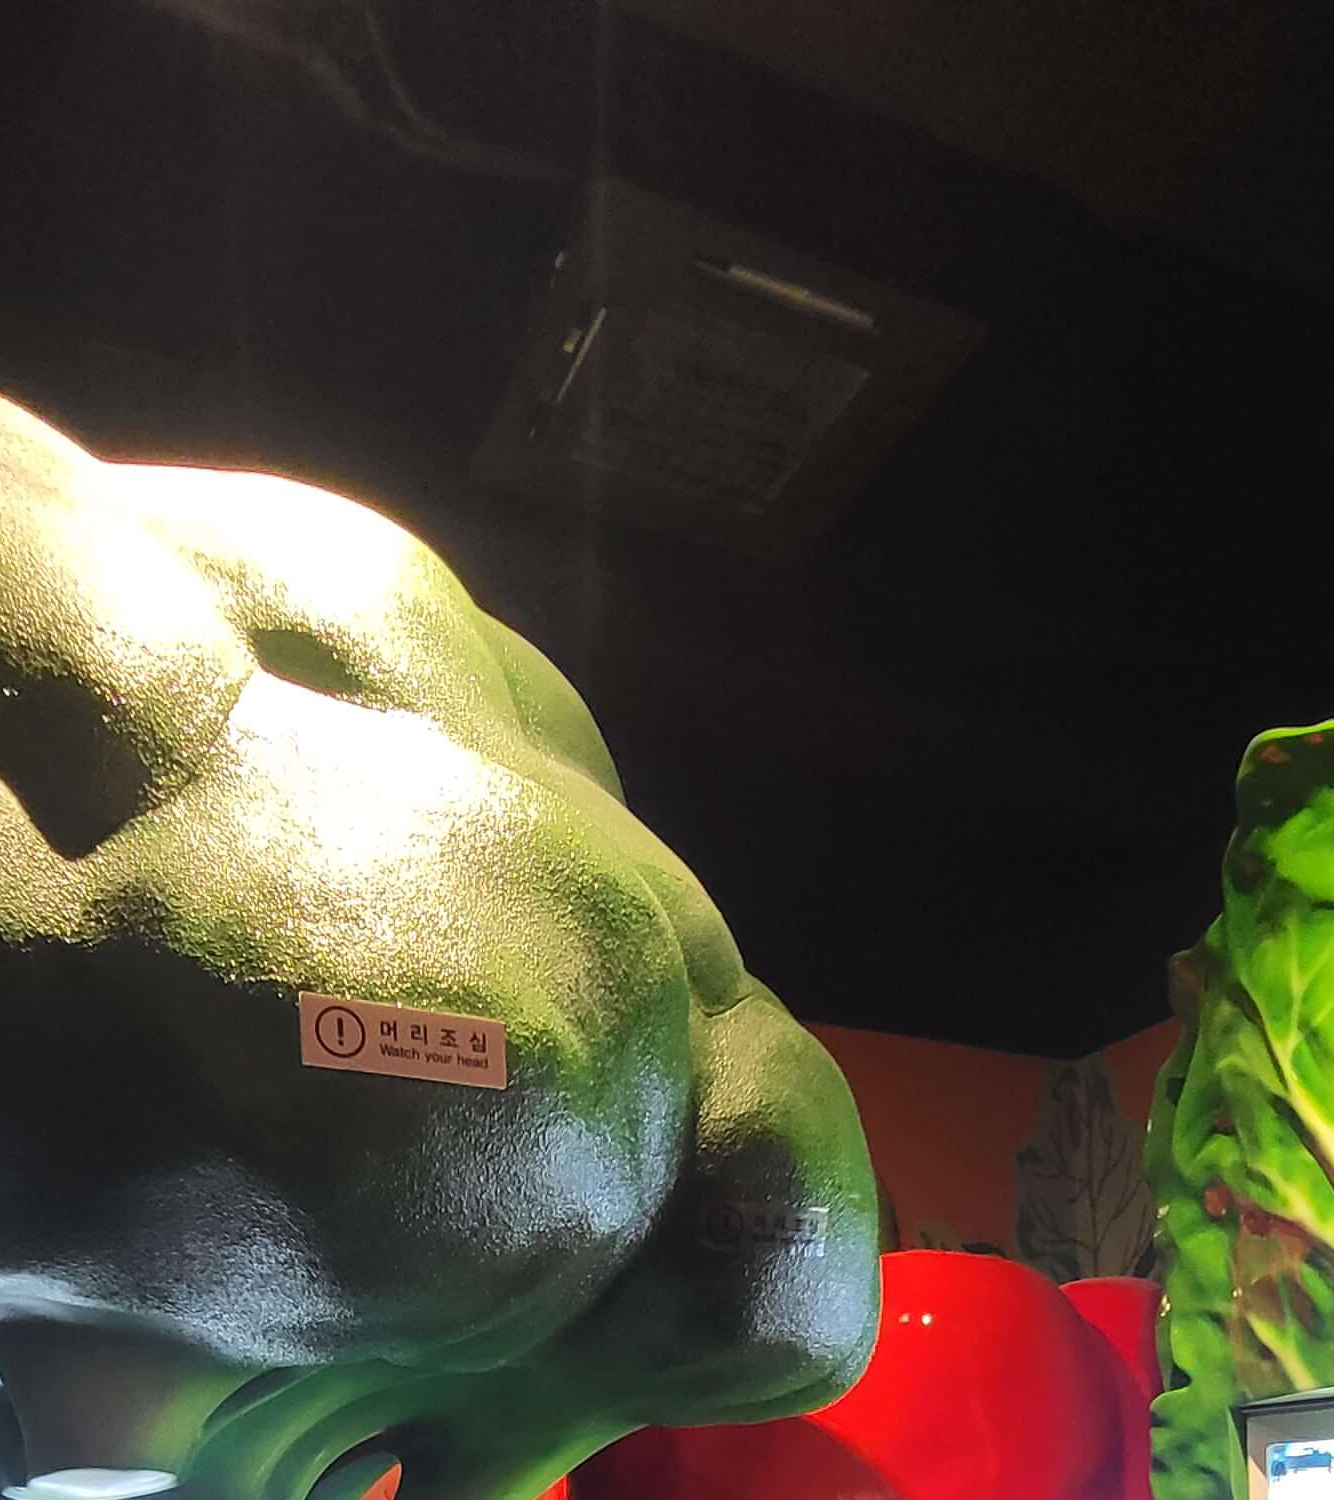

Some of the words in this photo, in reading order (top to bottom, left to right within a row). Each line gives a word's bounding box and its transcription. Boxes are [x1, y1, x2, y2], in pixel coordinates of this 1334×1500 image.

[379, 1044, 420, 1061] Watch
[423, 1051, 453, 1065] your
[456, 1053, 489, 1069] head
